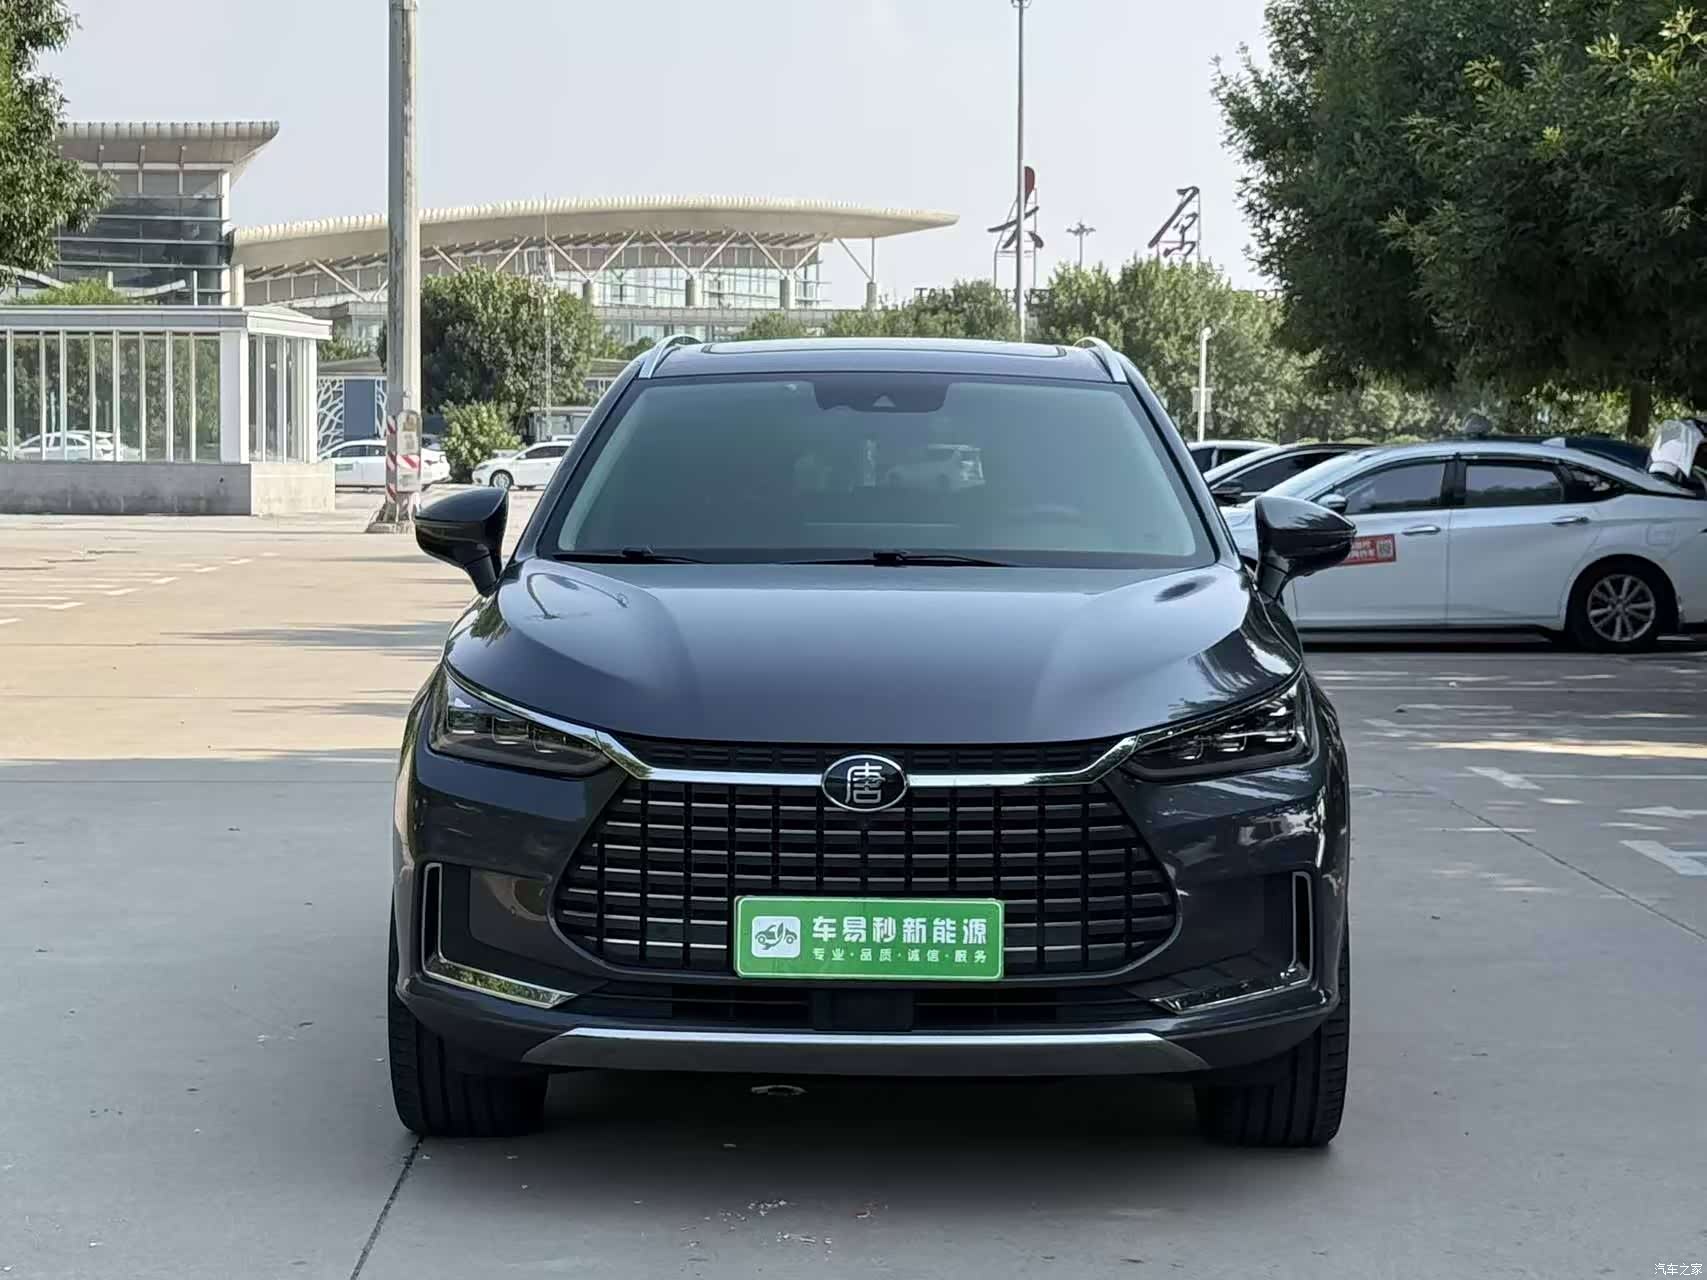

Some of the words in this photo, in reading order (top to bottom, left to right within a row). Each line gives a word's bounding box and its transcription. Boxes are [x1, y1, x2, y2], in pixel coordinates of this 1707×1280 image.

[845, 762, 886, 803] 唐
[812, 916, 988, 944] 车易秒新能源
